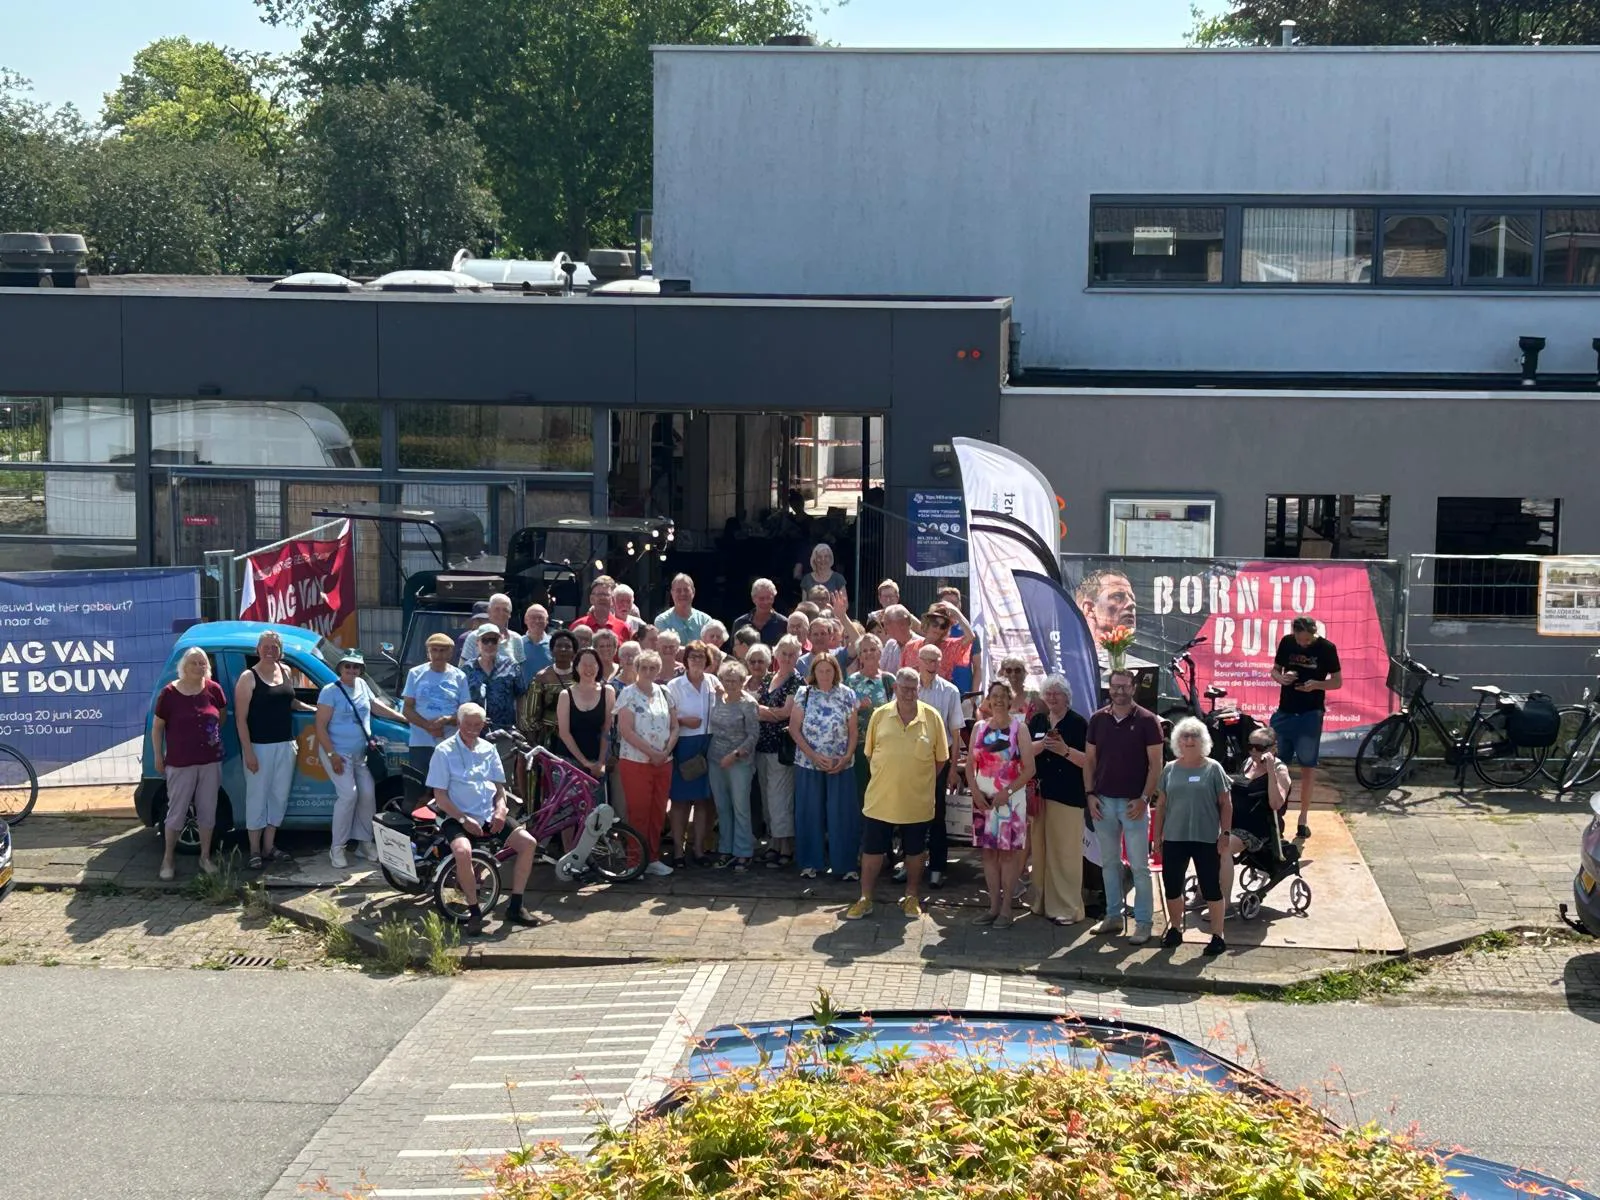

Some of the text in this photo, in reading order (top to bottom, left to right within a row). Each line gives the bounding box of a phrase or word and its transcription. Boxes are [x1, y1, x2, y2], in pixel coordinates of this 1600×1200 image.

[35, 603, 56, 613] wat
[58, 602, 79, 613] hier
[82, 600, 133, 614] gebeurt?
[267, 583, 297, 624] DAG
[1153, 575, 1316, 615] BORN TO
[4, 616, 51, 627] naar de
[1214, 617, 1327, 657] BUI
[0, 640, 115, 664] AG VAN
[1, 668, 130, 693] E BOUW
[35, 710, 51, 720] 20
[52, 709, 72, 722] juni
[74, 709, 103, 720] 2026
[55, 726, 73, 734] uur
